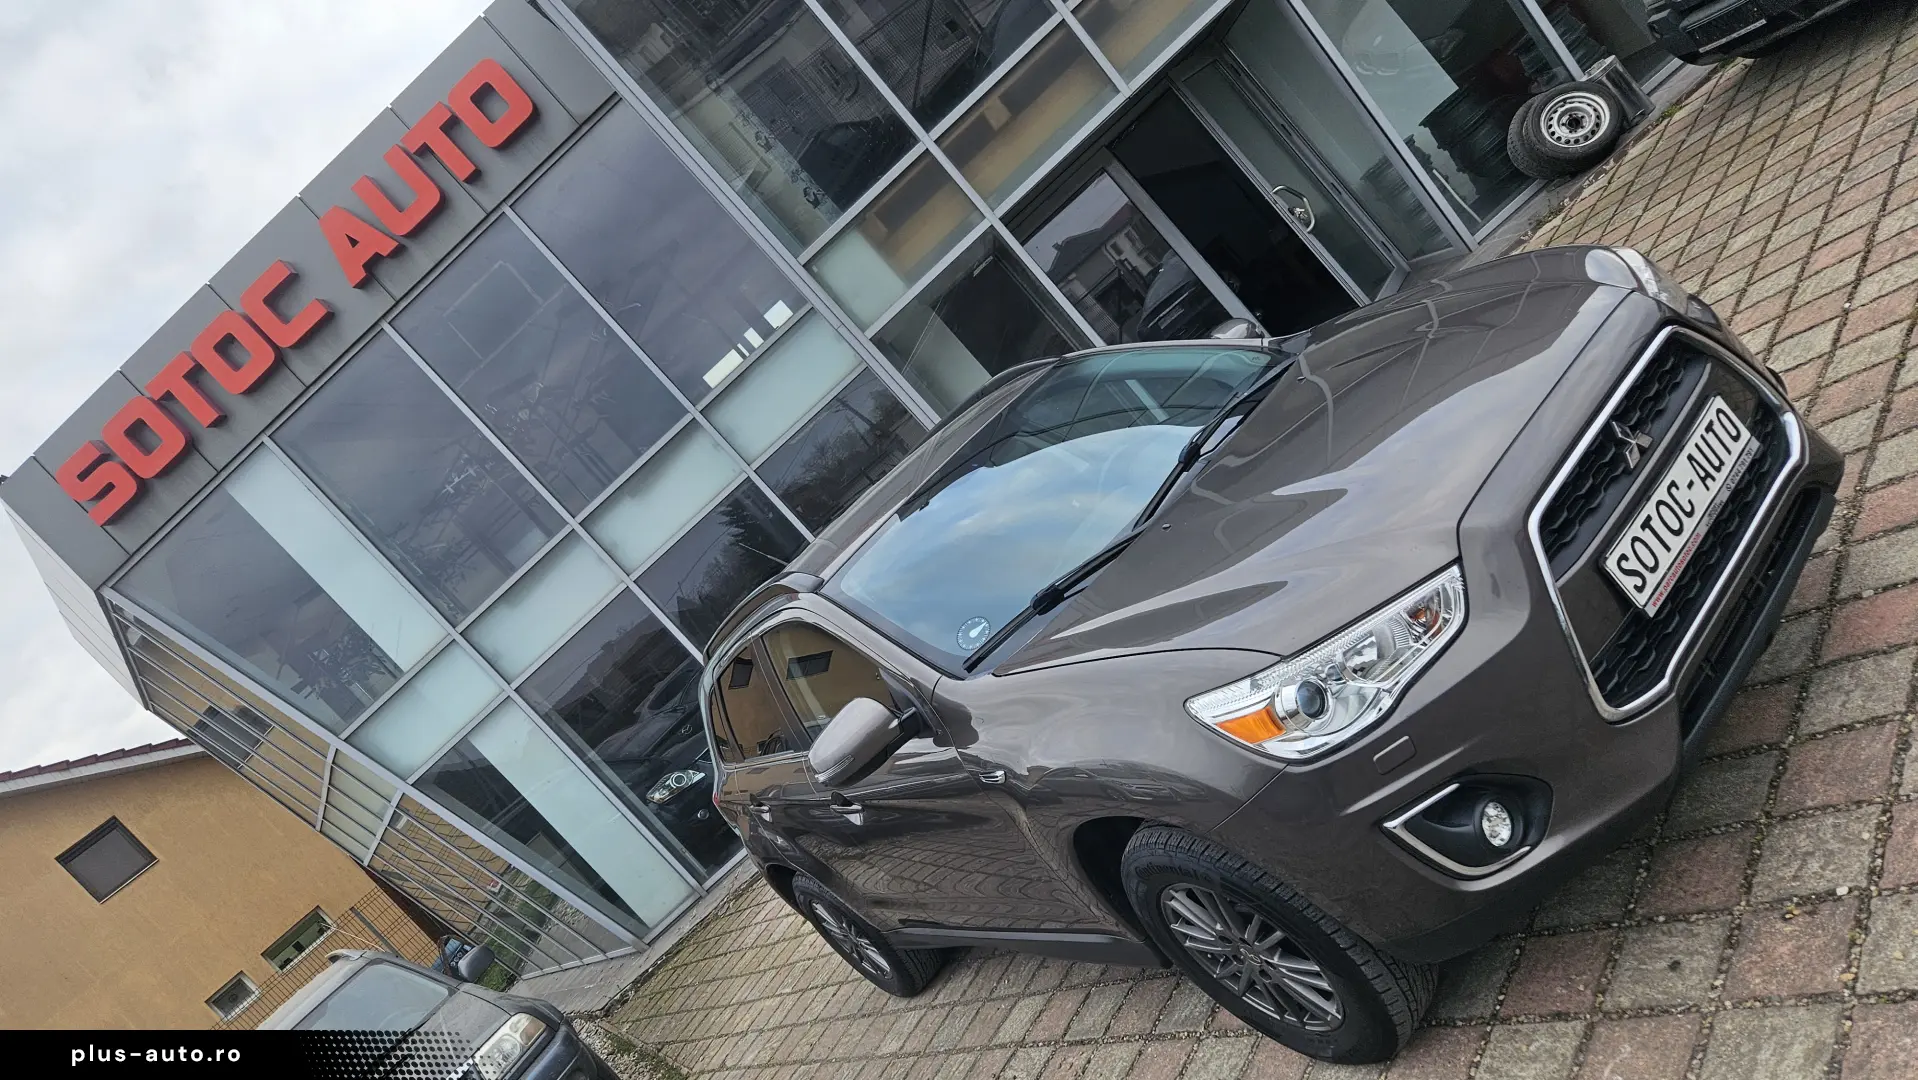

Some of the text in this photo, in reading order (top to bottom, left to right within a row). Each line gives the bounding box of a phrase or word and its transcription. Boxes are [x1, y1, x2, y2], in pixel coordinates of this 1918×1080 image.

[55, 58, 537, 526] SOTOC AUTO
[1616, 407, 1742, 594] SOTOC-AUTO
